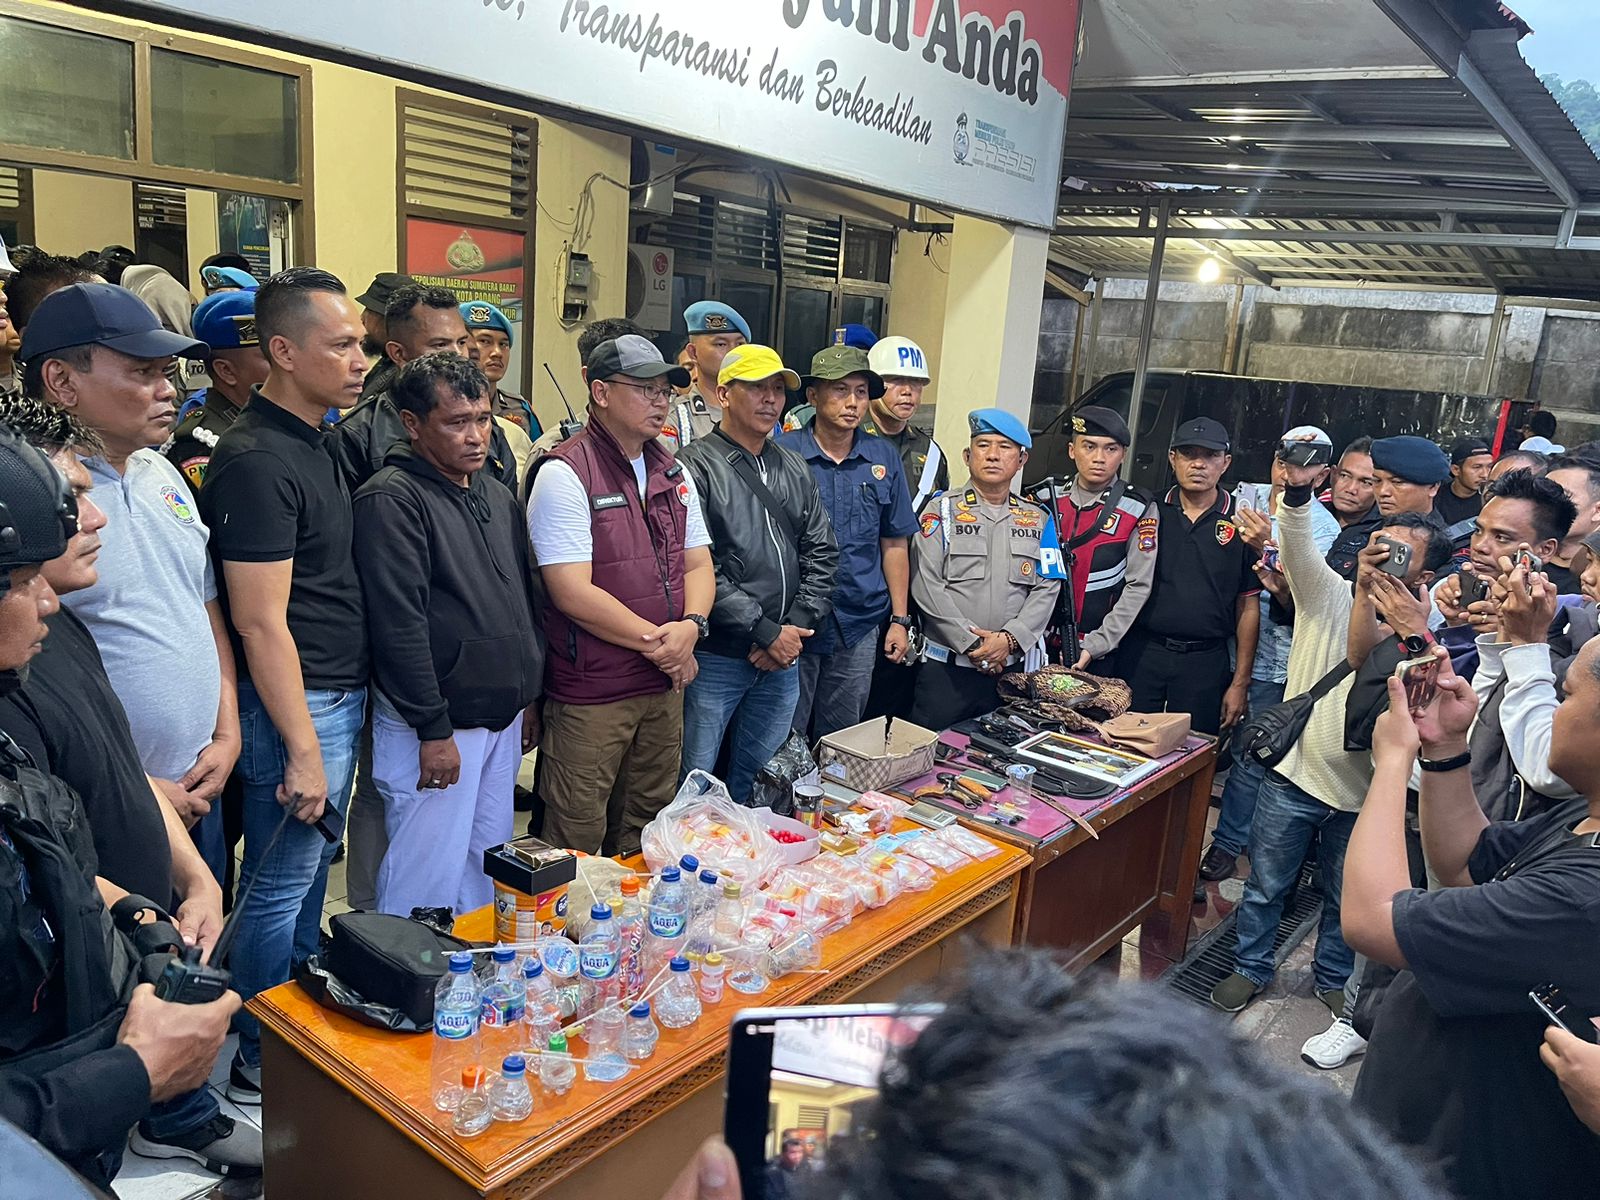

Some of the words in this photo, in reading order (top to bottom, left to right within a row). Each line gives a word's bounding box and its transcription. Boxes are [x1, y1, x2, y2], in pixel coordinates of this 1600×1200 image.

[922, 0, 1039, 106] Anda
[559, 0, 751, 88] Transparansi
[759, 46, 805, 105] dan
[815, 59, 932, 146] Berkeadilan
[446, 278, 469, 289] DAERAH
[469, 281, 499, 292] SUMATERA
[499, 283, 516, 294] BARAT
[653, 279, 666, 291] LG
[456, 290, 473, 302] KOTA
[474, 292, 501, 305] PADANG
[897, 346, 923, 369] PM
[955, 525, 981, 535] BOY
[1011, 528, 1041, 541] POLRI
[653, 916, 679, 928] AQUA
[583, 956, 609, 969] AQUA
[440, 1015, 470, 1028] AQUA
